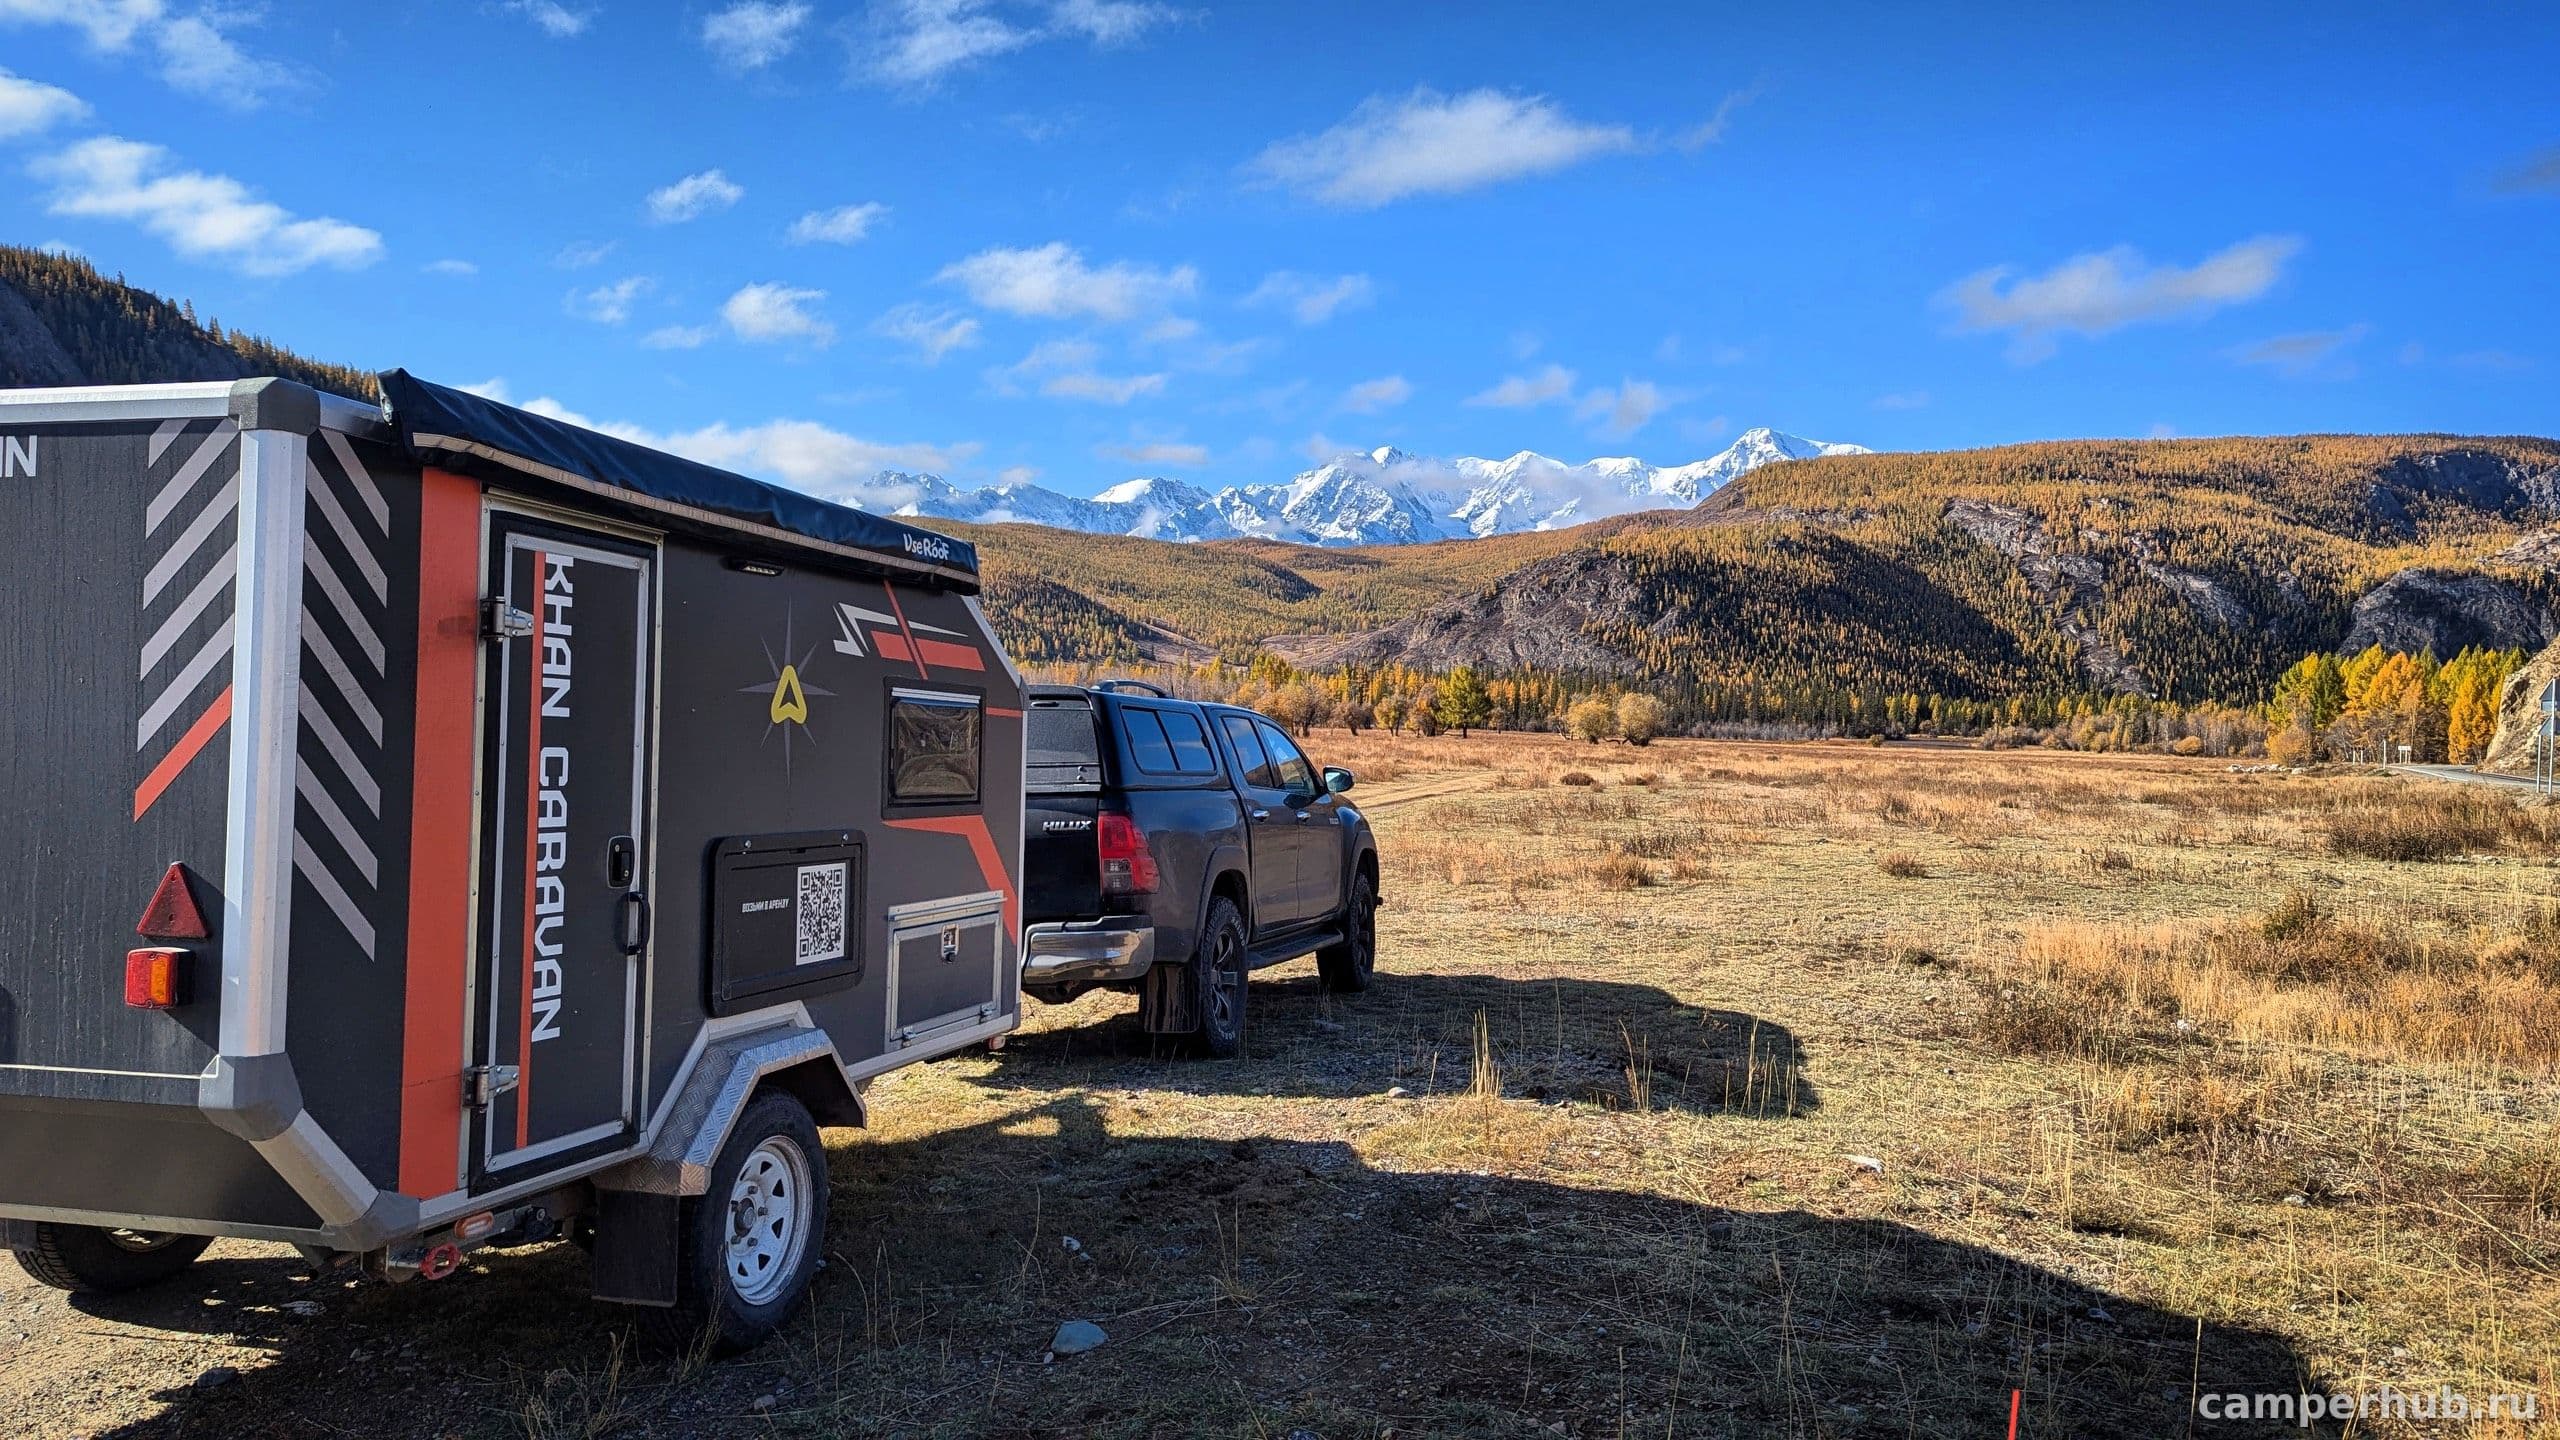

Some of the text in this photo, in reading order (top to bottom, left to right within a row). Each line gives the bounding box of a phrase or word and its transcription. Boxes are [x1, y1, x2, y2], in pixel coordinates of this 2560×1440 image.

[0, 435, 38, 478] N
[531, 552, 574, 1043] KHAN CARAVAN
[1042, 820, 1092, 831] HILUX
